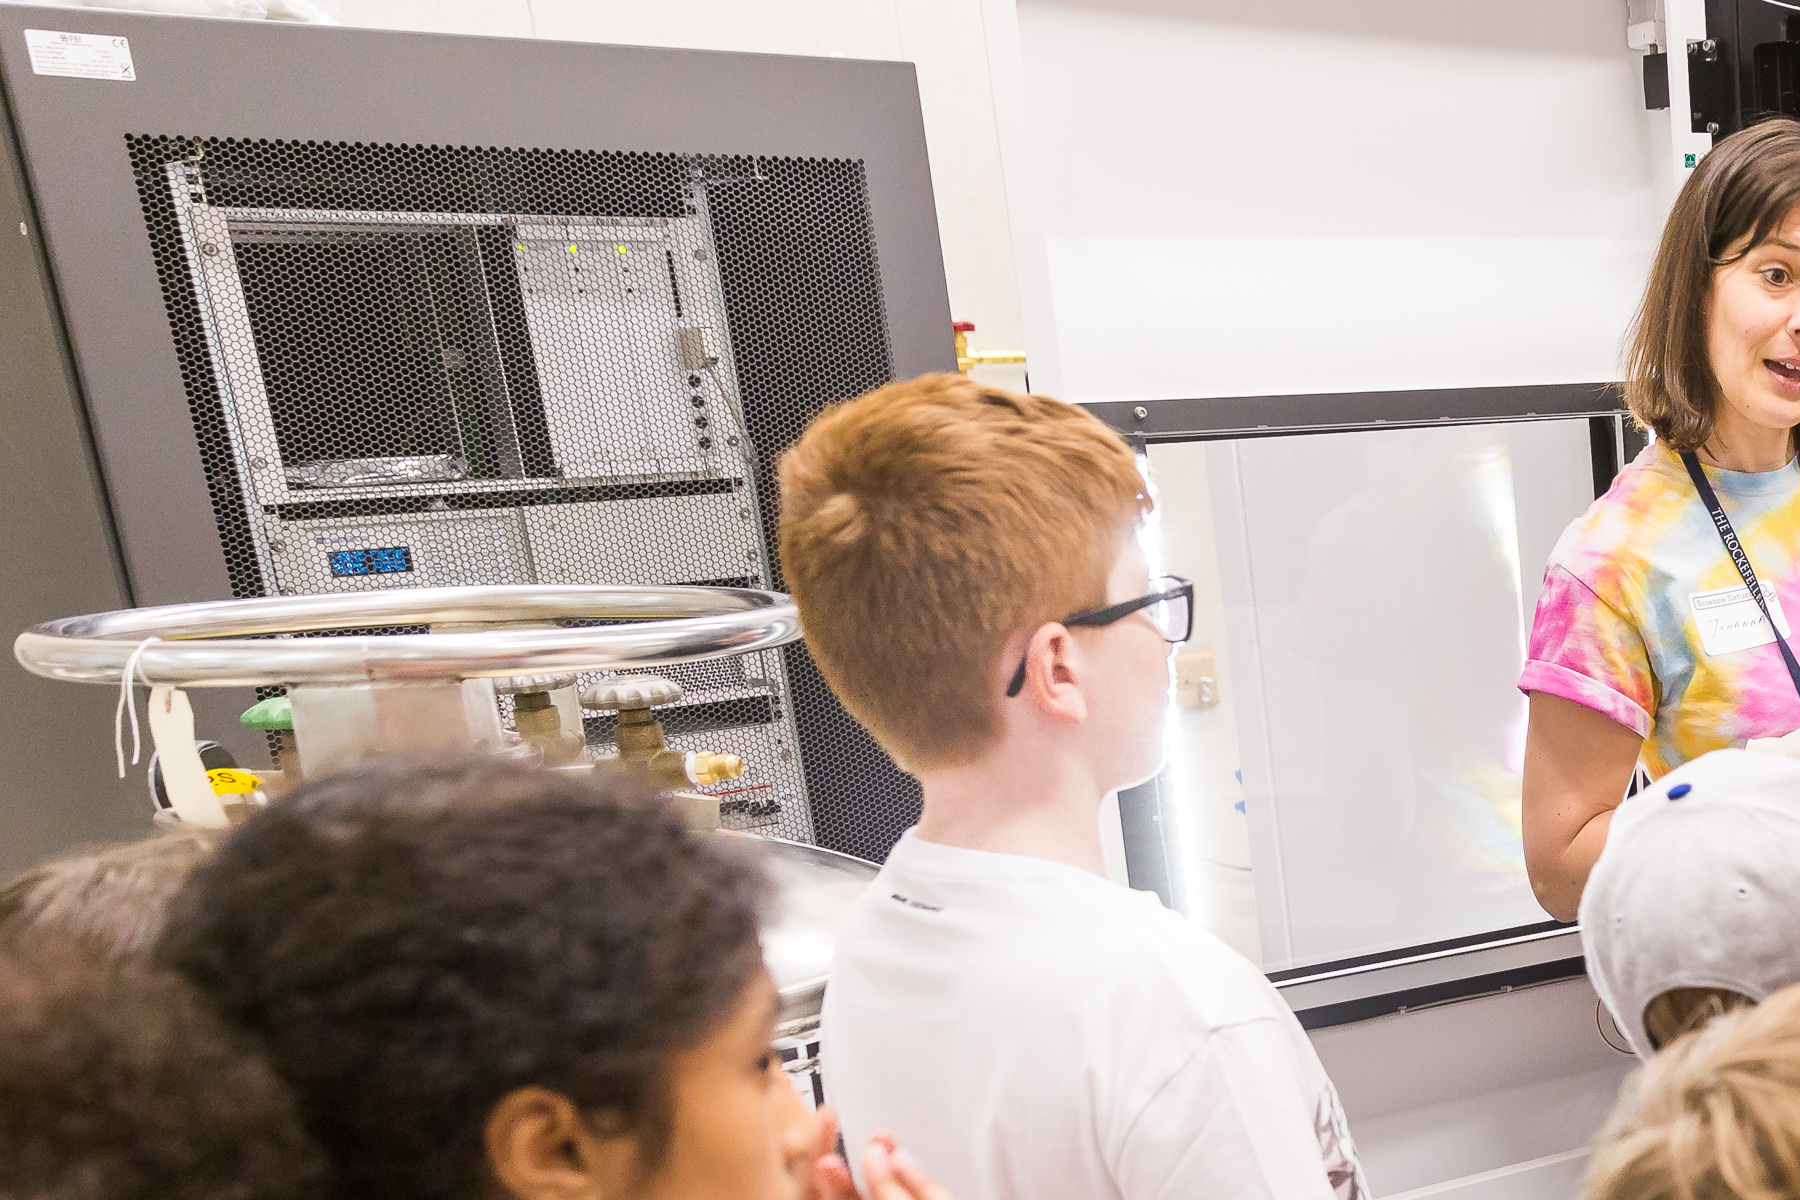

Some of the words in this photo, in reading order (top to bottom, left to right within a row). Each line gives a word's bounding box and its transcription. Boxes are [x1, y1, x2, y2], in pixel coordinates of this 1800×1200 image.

[1712, 507, 1729, 533] THE
[1696, 597, 1726, 607] Science
[1727, 591, 1753, 602] Satur
